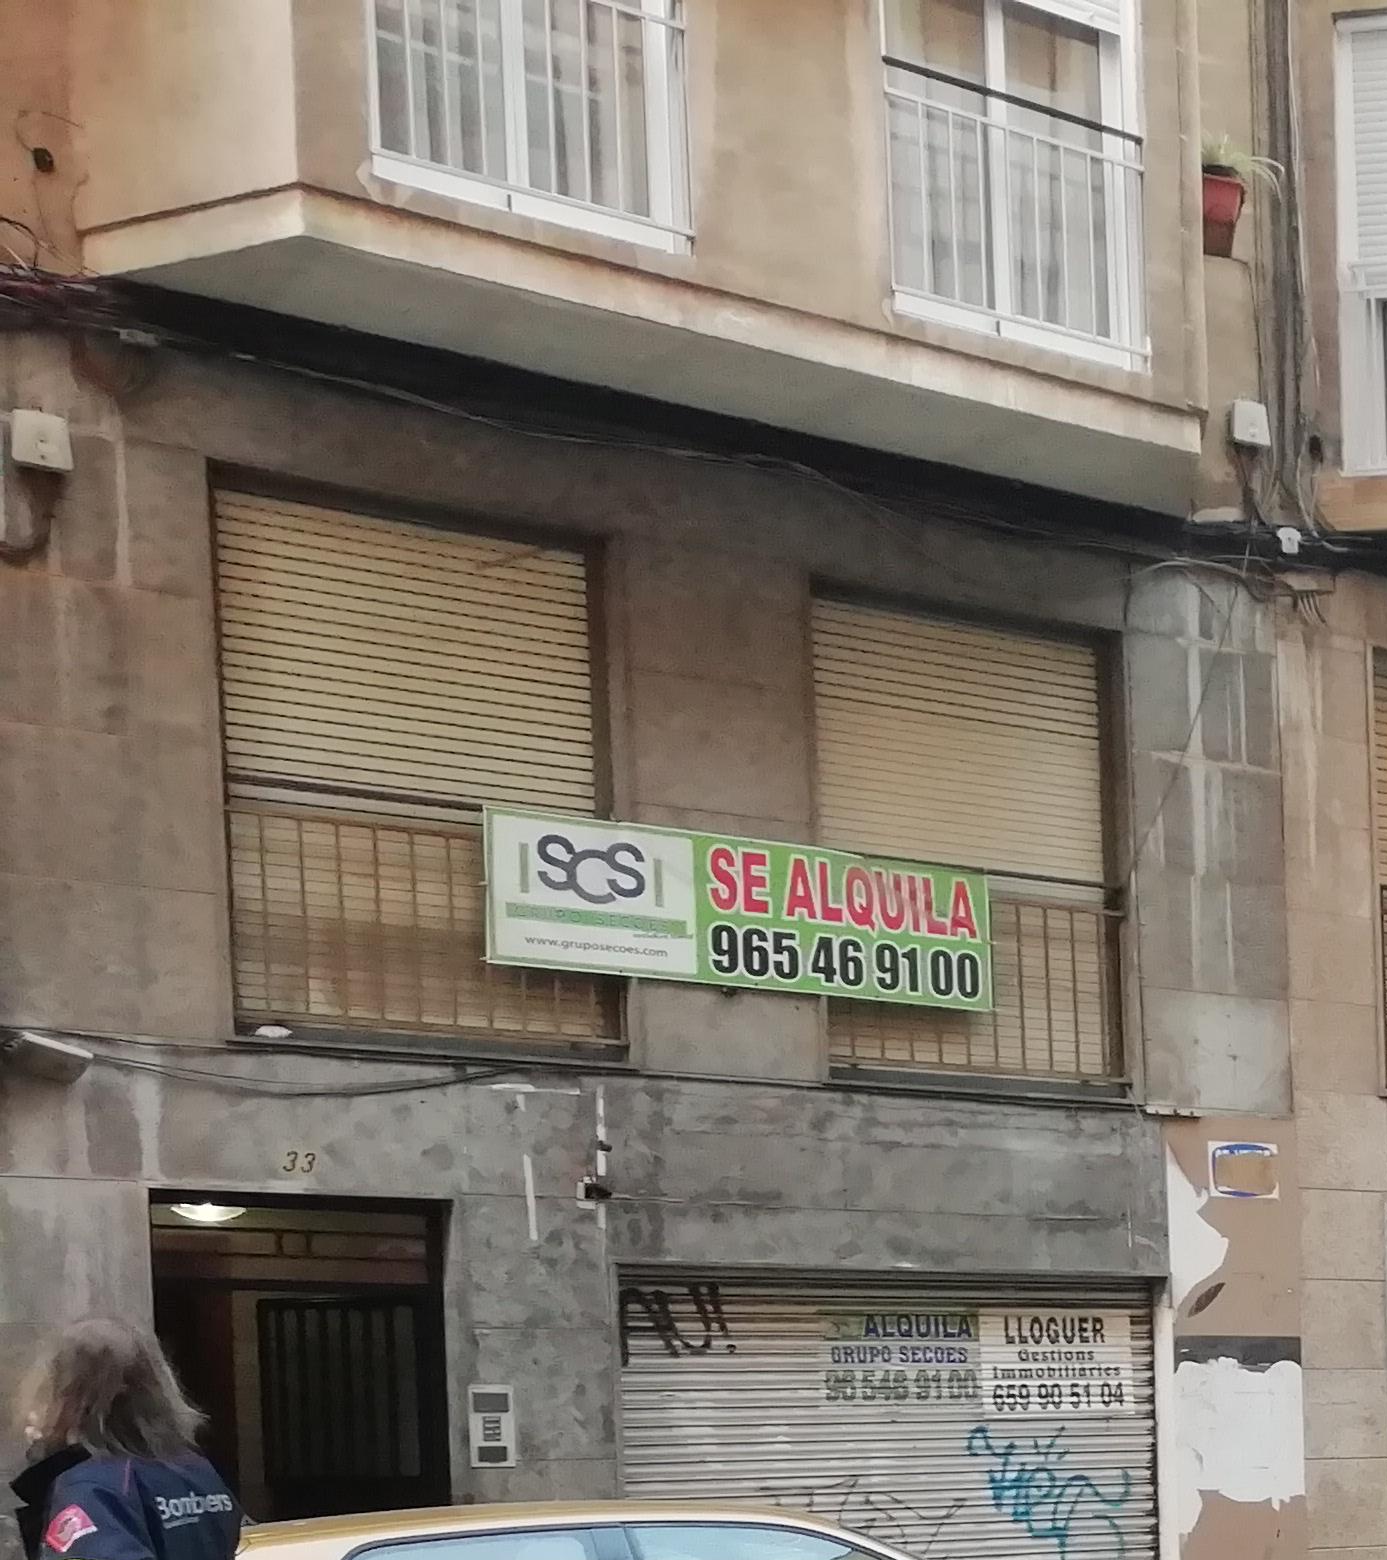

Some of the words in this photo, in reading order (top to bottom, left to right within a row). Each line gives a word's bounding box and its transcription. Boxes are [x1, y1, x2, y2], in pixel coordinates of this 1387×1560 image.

[709, 846, 770, 914] SE
[785, 857, 978, 939] ALQUILA
[524, 934, 669, 959] www.gruposecoes.com
[711, 923, 799, 981] 965
[811, 935, 864, 987] 46
[875, 942, 920, 993] 91
[930, 949, 980, 1000] 00
[282, 1150, 318, 1174] 33
[864, 1313, 973, 1339] ALQUILA
[1004, 1315, 1106, 1345] LLOGUER
[831, 1345, 892, 1364] GRUPO
[899, 1346, 969, 1364] SECOES
[1017, 1348, 1096, 1362] Gestions
